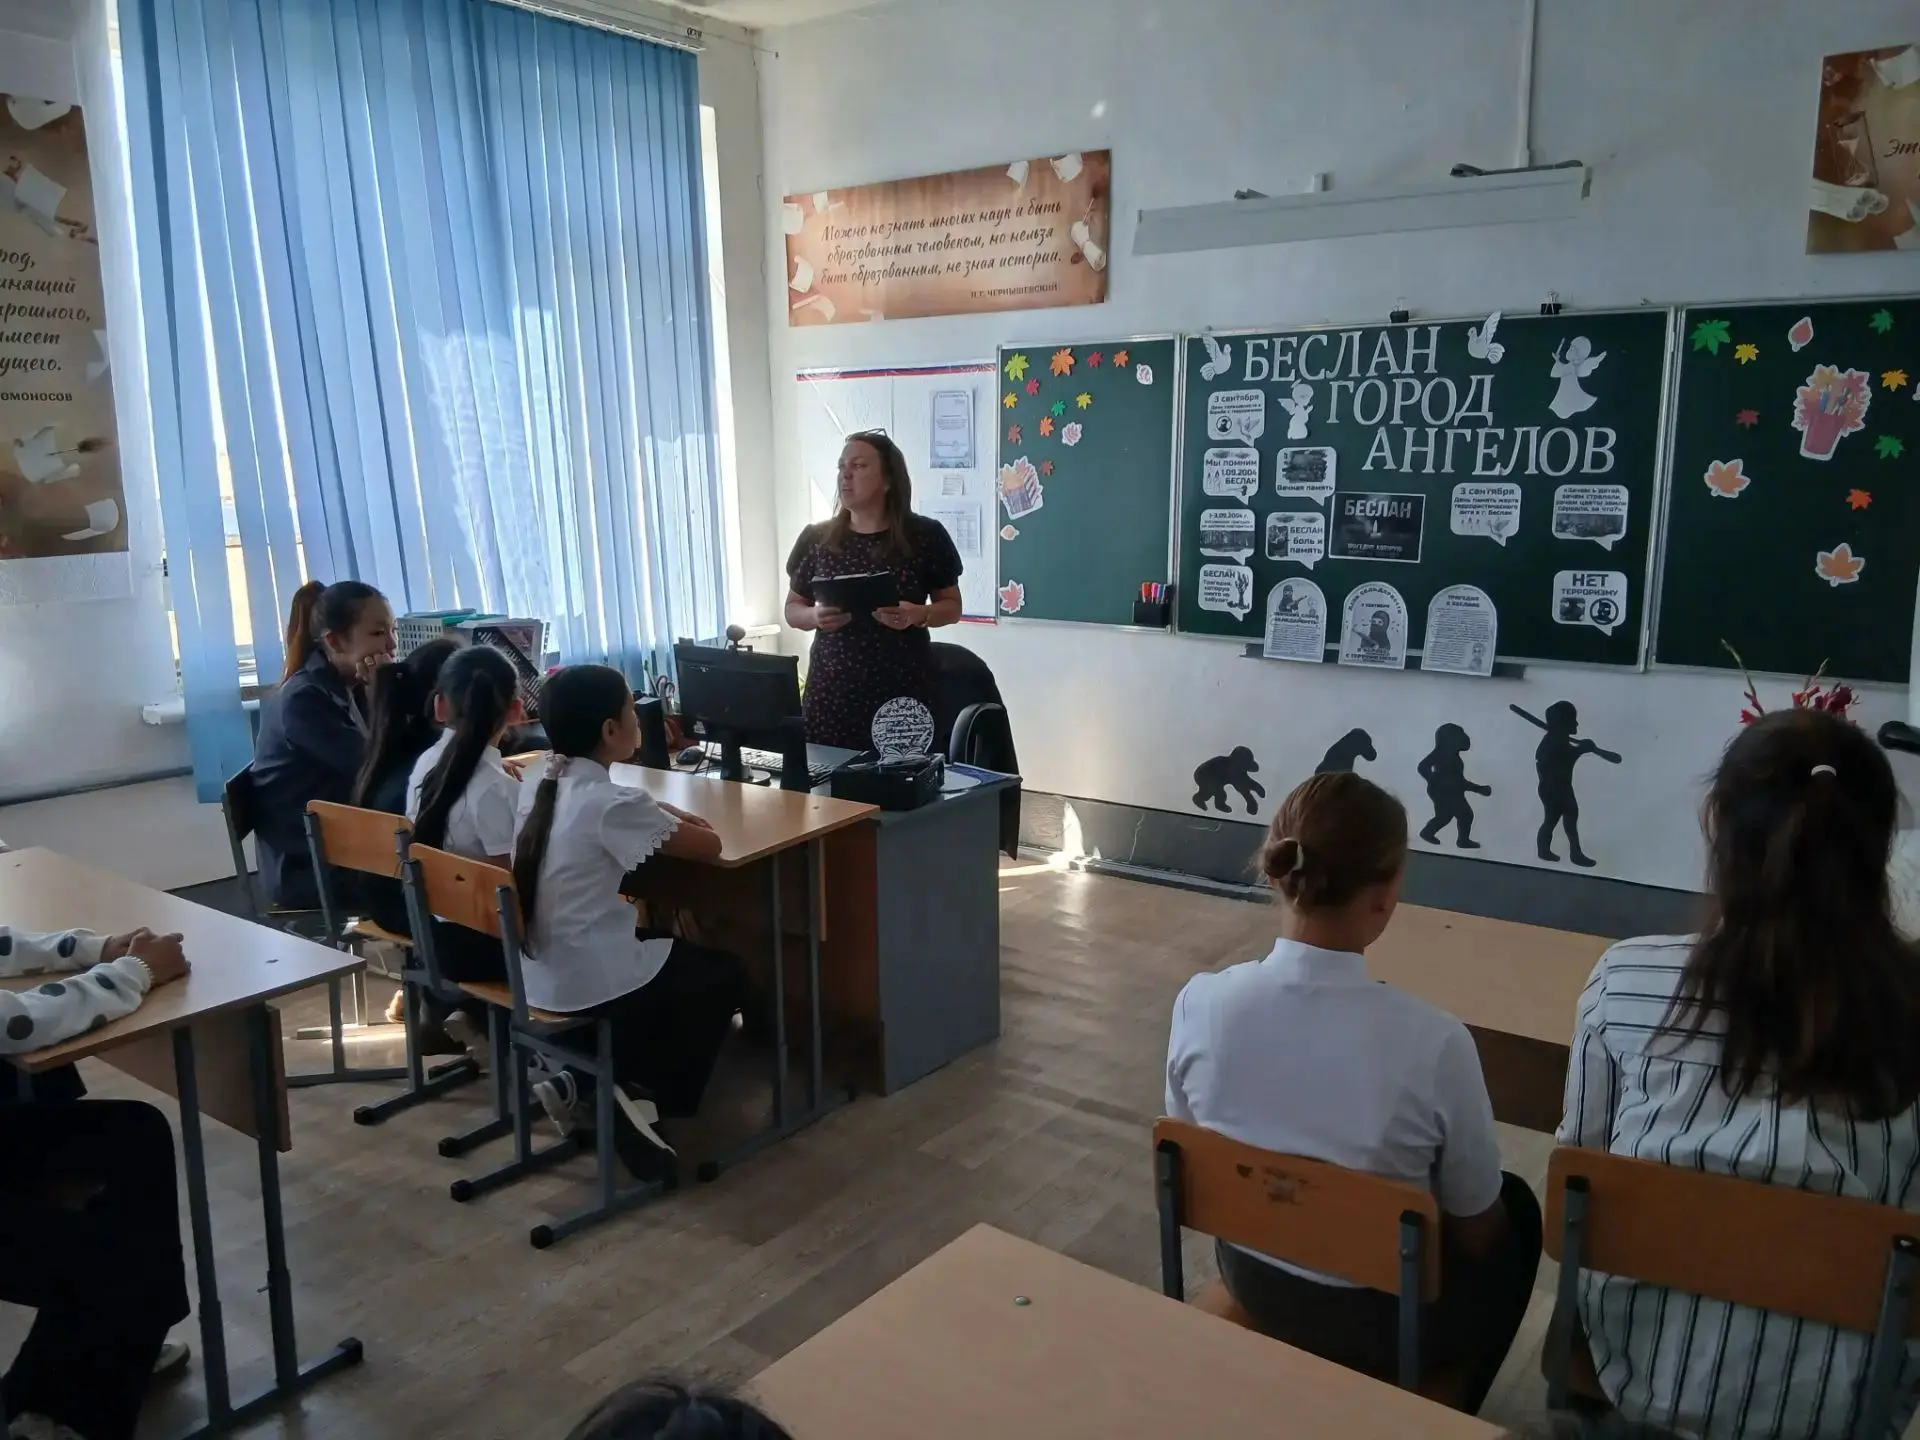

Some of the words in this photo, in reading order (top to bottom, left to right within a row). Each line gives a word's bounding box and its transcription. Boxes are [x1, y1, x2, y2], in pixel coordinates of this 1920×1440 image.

[1883, 138, 1920, 157] Эт
[822, 225, 867, 241] Можно
[870, 223, 884, 235] не
[885, 218, 925, 239] знать
[930, 213, 975, 228] многих
[980, 208, 1011, 227] наук
[1016, 206, 1023, 218] и
[1028, 197, 1061, 216] быть
[828, 242, 912, 266] образованным
[917, 233, 984, 253] человеком,
[990, 233, 1005, 245] но
[1010, 227, 1054, 246] нельзя
[821, 268, 847, 284] быть
[852, 261, 941, 286] образованным,
[947, 262, 961, 273] не
[963, 258, 994, 278] зная
[1000, 251, 1061, 271] истории.
[988, 282, 1057, 297] ЧЕРНЫШЕВСКИЙ
[1243, 326, 1441, 382] БЕСЛАН
[1326, 374, 1494, 427] ГОРОД
[1362, 426, 1617, 477] АНГЕЛОВ
[1460, 487, 1466, 495] 3
[1469, 487, 1515, 496] сентября
[1344, 499, 1412, 519] БЕСЛАН
[1290, 526, 1323, 534] БЕСЛАН
[1203, 570, 1235, 578] БЕСЛАН
[1572, 573, 1609, 587] НЕТ
[1561, 588, 1618, 596] ТЕРРОРИЗМУ
